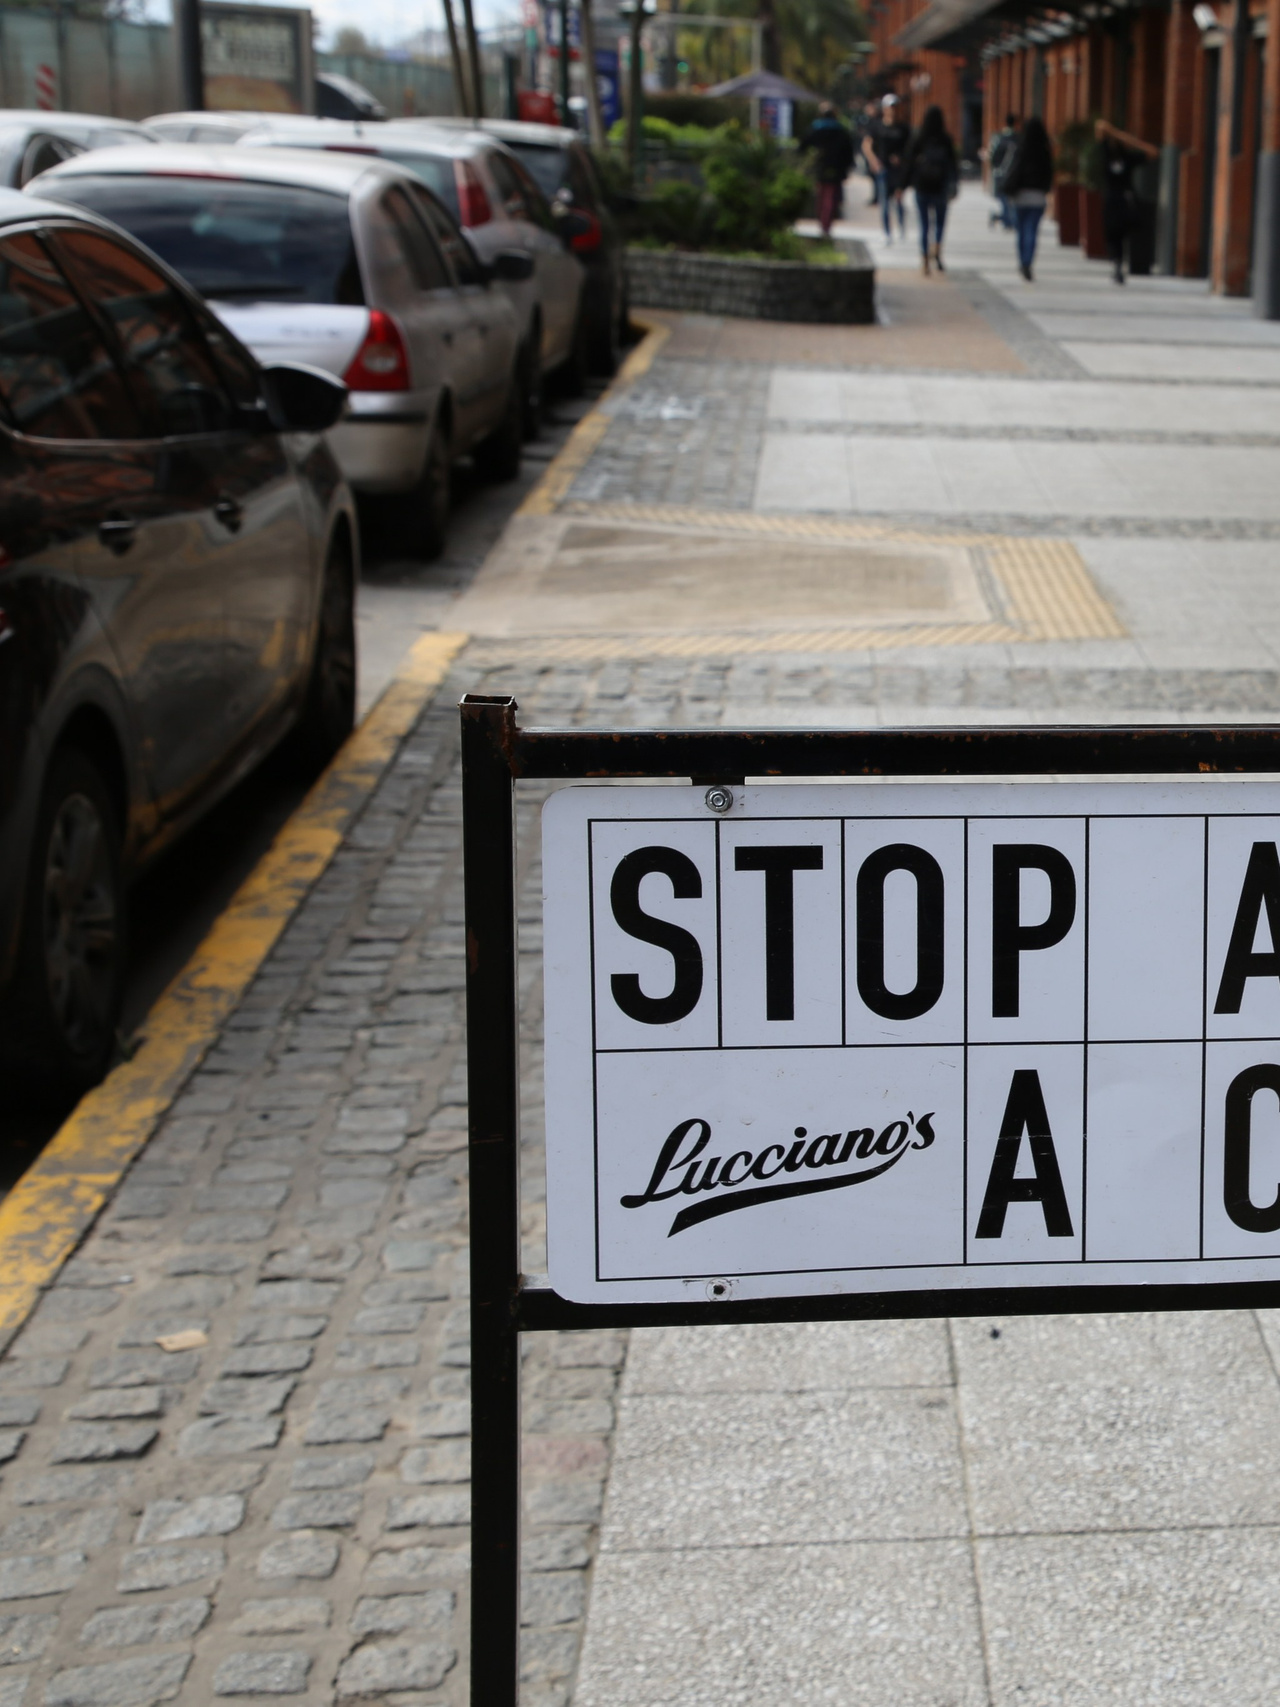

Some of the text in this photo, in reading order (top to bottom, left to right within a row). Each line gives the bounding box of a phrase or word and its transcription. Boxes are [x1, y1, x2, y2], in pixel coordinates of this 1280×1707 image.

[609, 842, 1077, 1025] STOP
[619, 1110, 936, 1209] Lucciano's
[974, 1069, 1075, 1239] A
